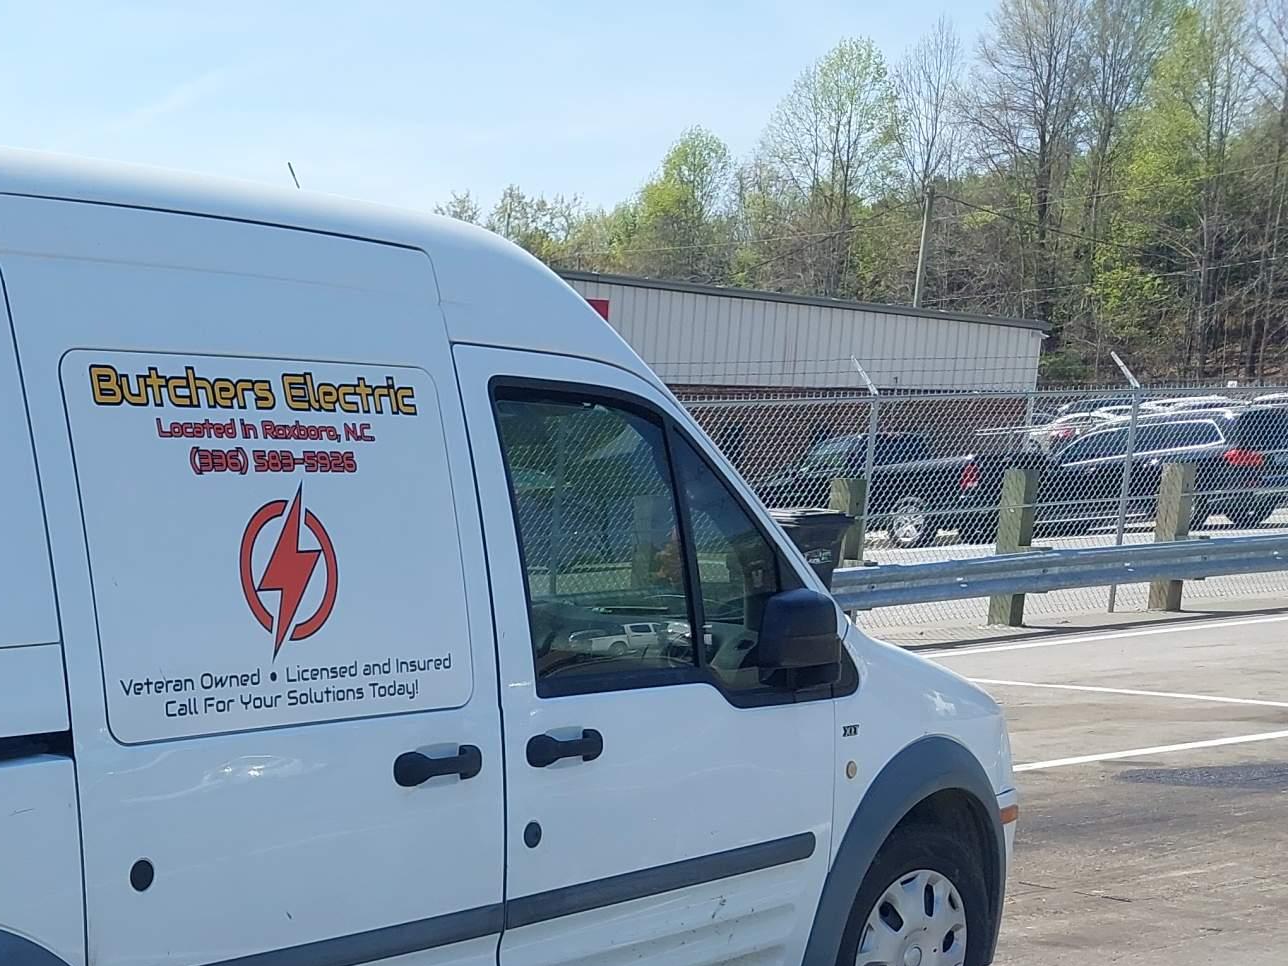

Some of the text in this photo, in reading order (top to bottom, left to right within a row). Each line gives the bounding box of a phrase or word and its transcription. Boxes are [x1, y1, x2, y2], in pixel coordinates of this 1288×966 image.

[88, 364, 418, 416] Butchers Electric
[156, 418, 236, 439] Located
[261, 420, 341, 443] Roxboro,
[344, 422, 375, 442] N.C.
[189, 446, 357, 475] (336) 583-5926
[119, 653, 452, 697] Veteran Owned Licensed and Insured
[165, 679, 420, 718] Call For Your Solutions Today!
